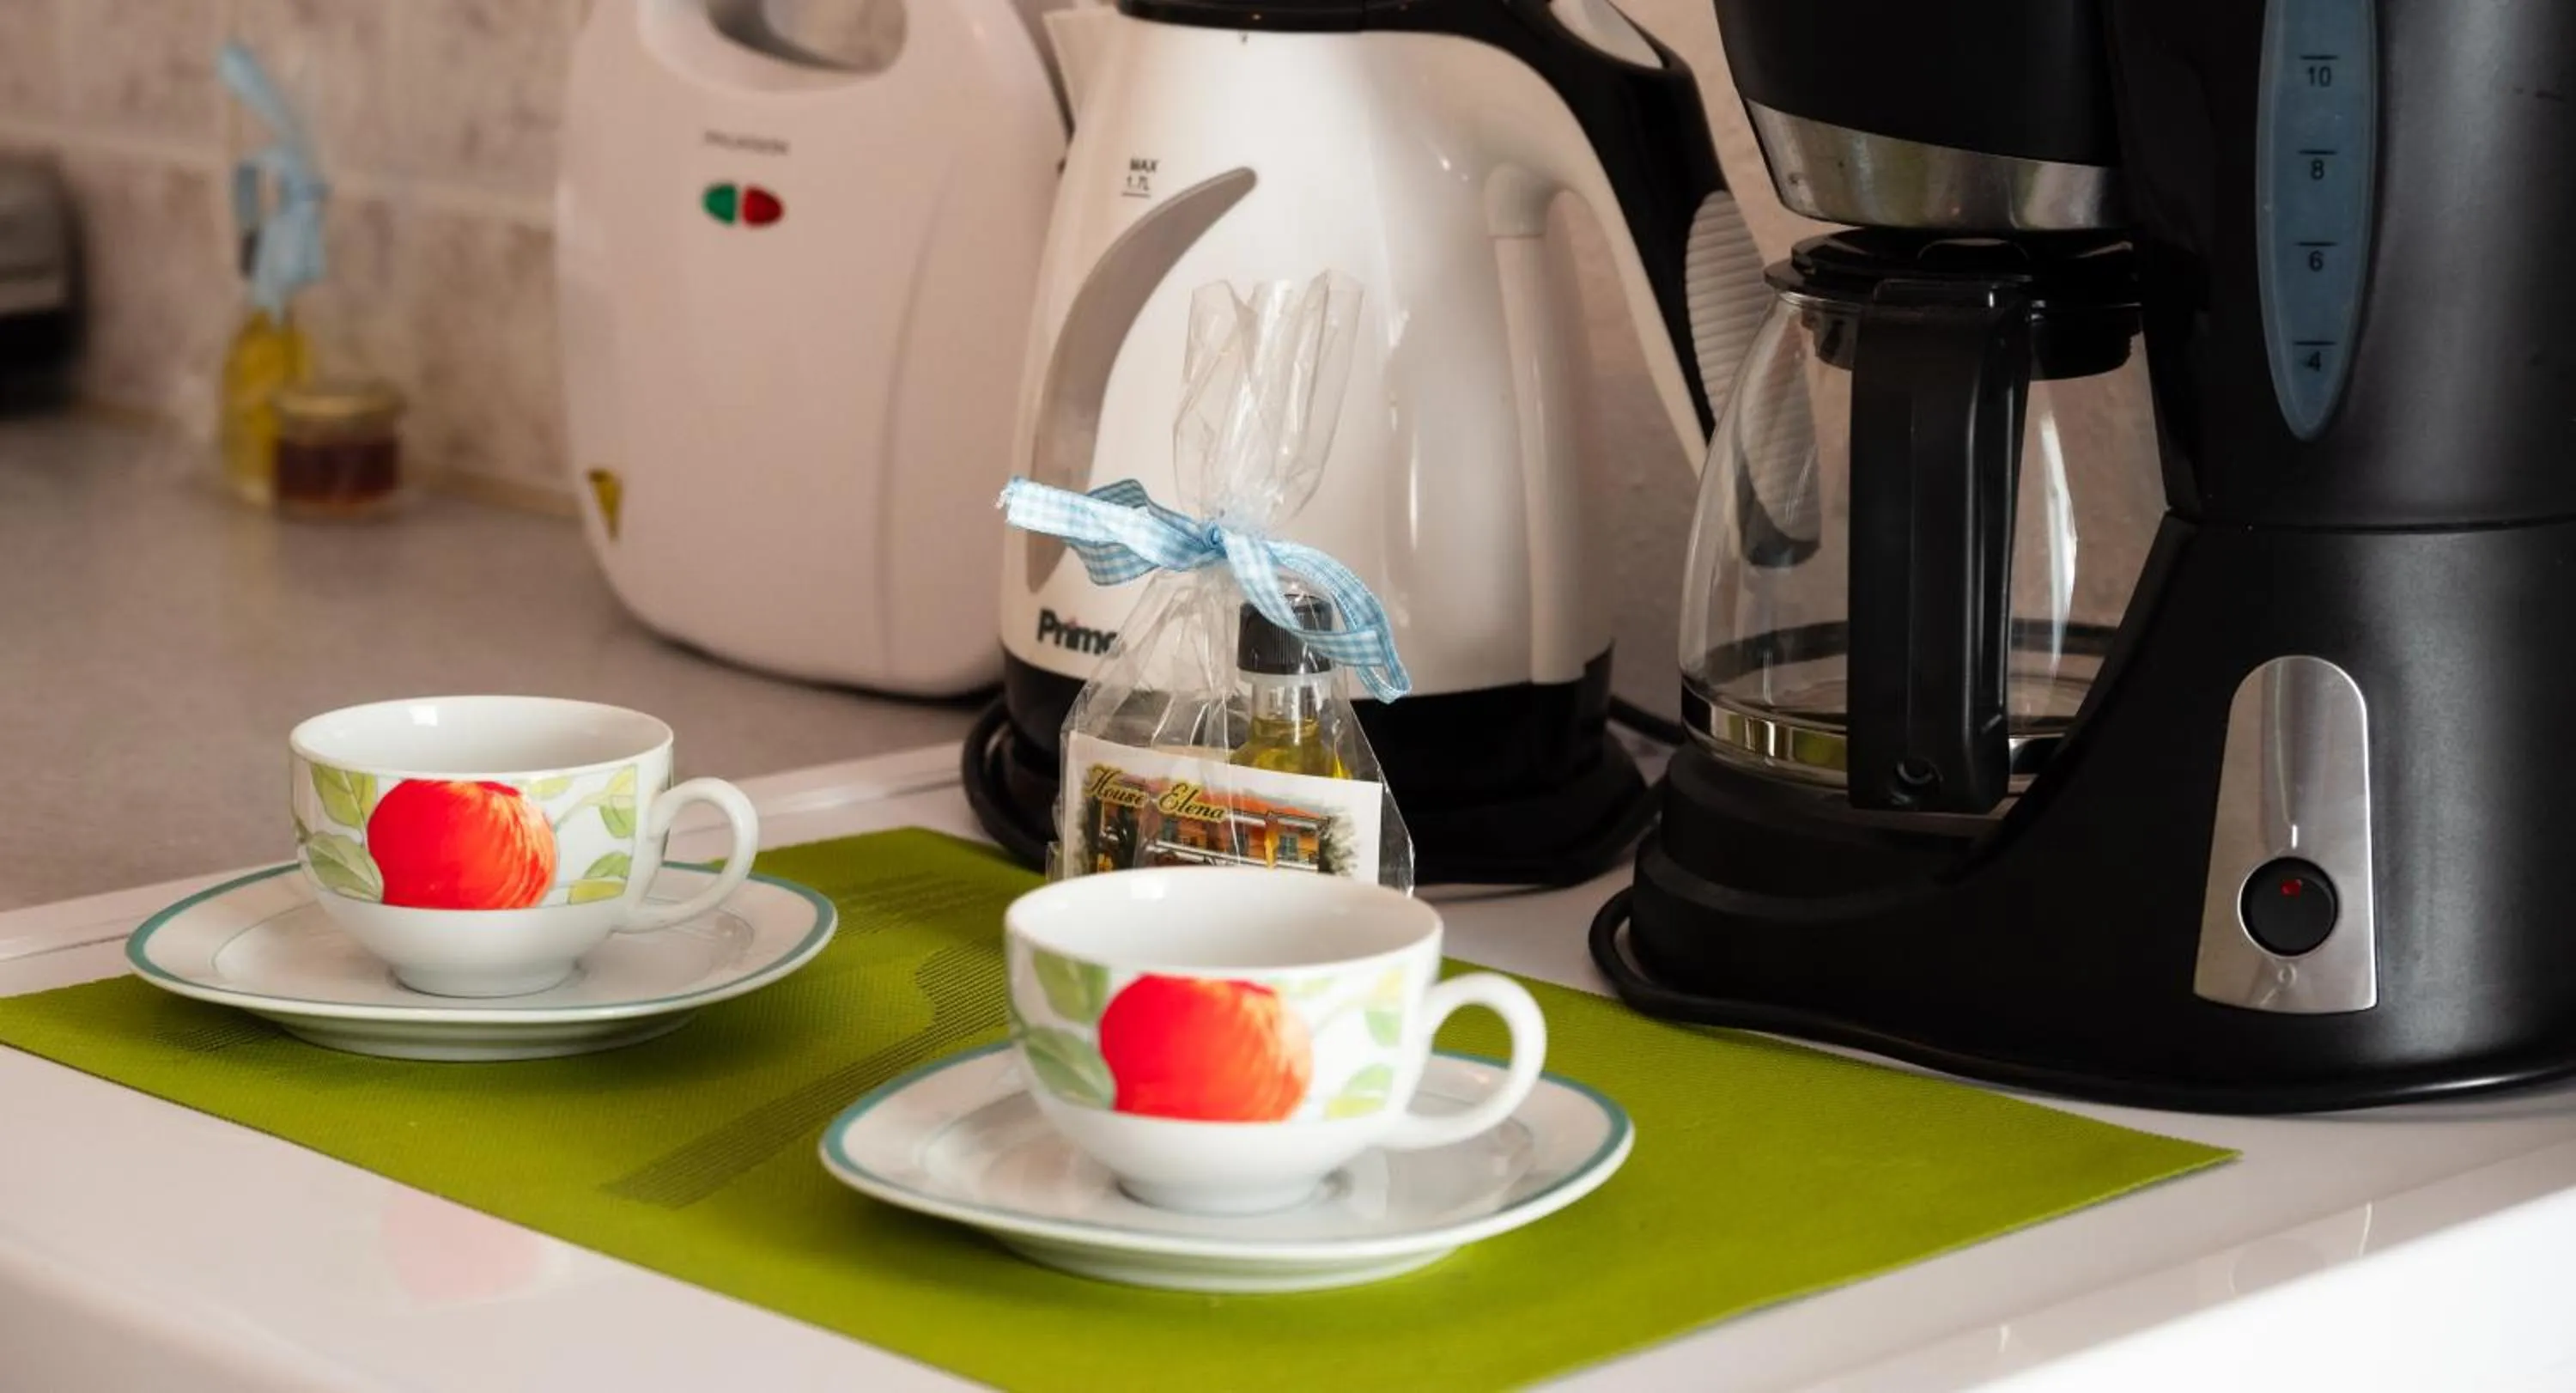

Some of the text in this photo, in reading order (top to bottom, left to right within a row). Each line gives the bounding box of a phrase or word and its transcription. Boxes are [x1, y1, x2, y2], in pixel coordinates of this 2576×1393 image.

[2306, 65, 2333, 88] 10
[1129, 157, 1161, 173] MAX
[2309, 158, 2326, 181] 8
[2308, 250, 2325, 272] 6
[2303, 350, 2324, 373] 4
[1087, 764, 1225, 819] House Elena
